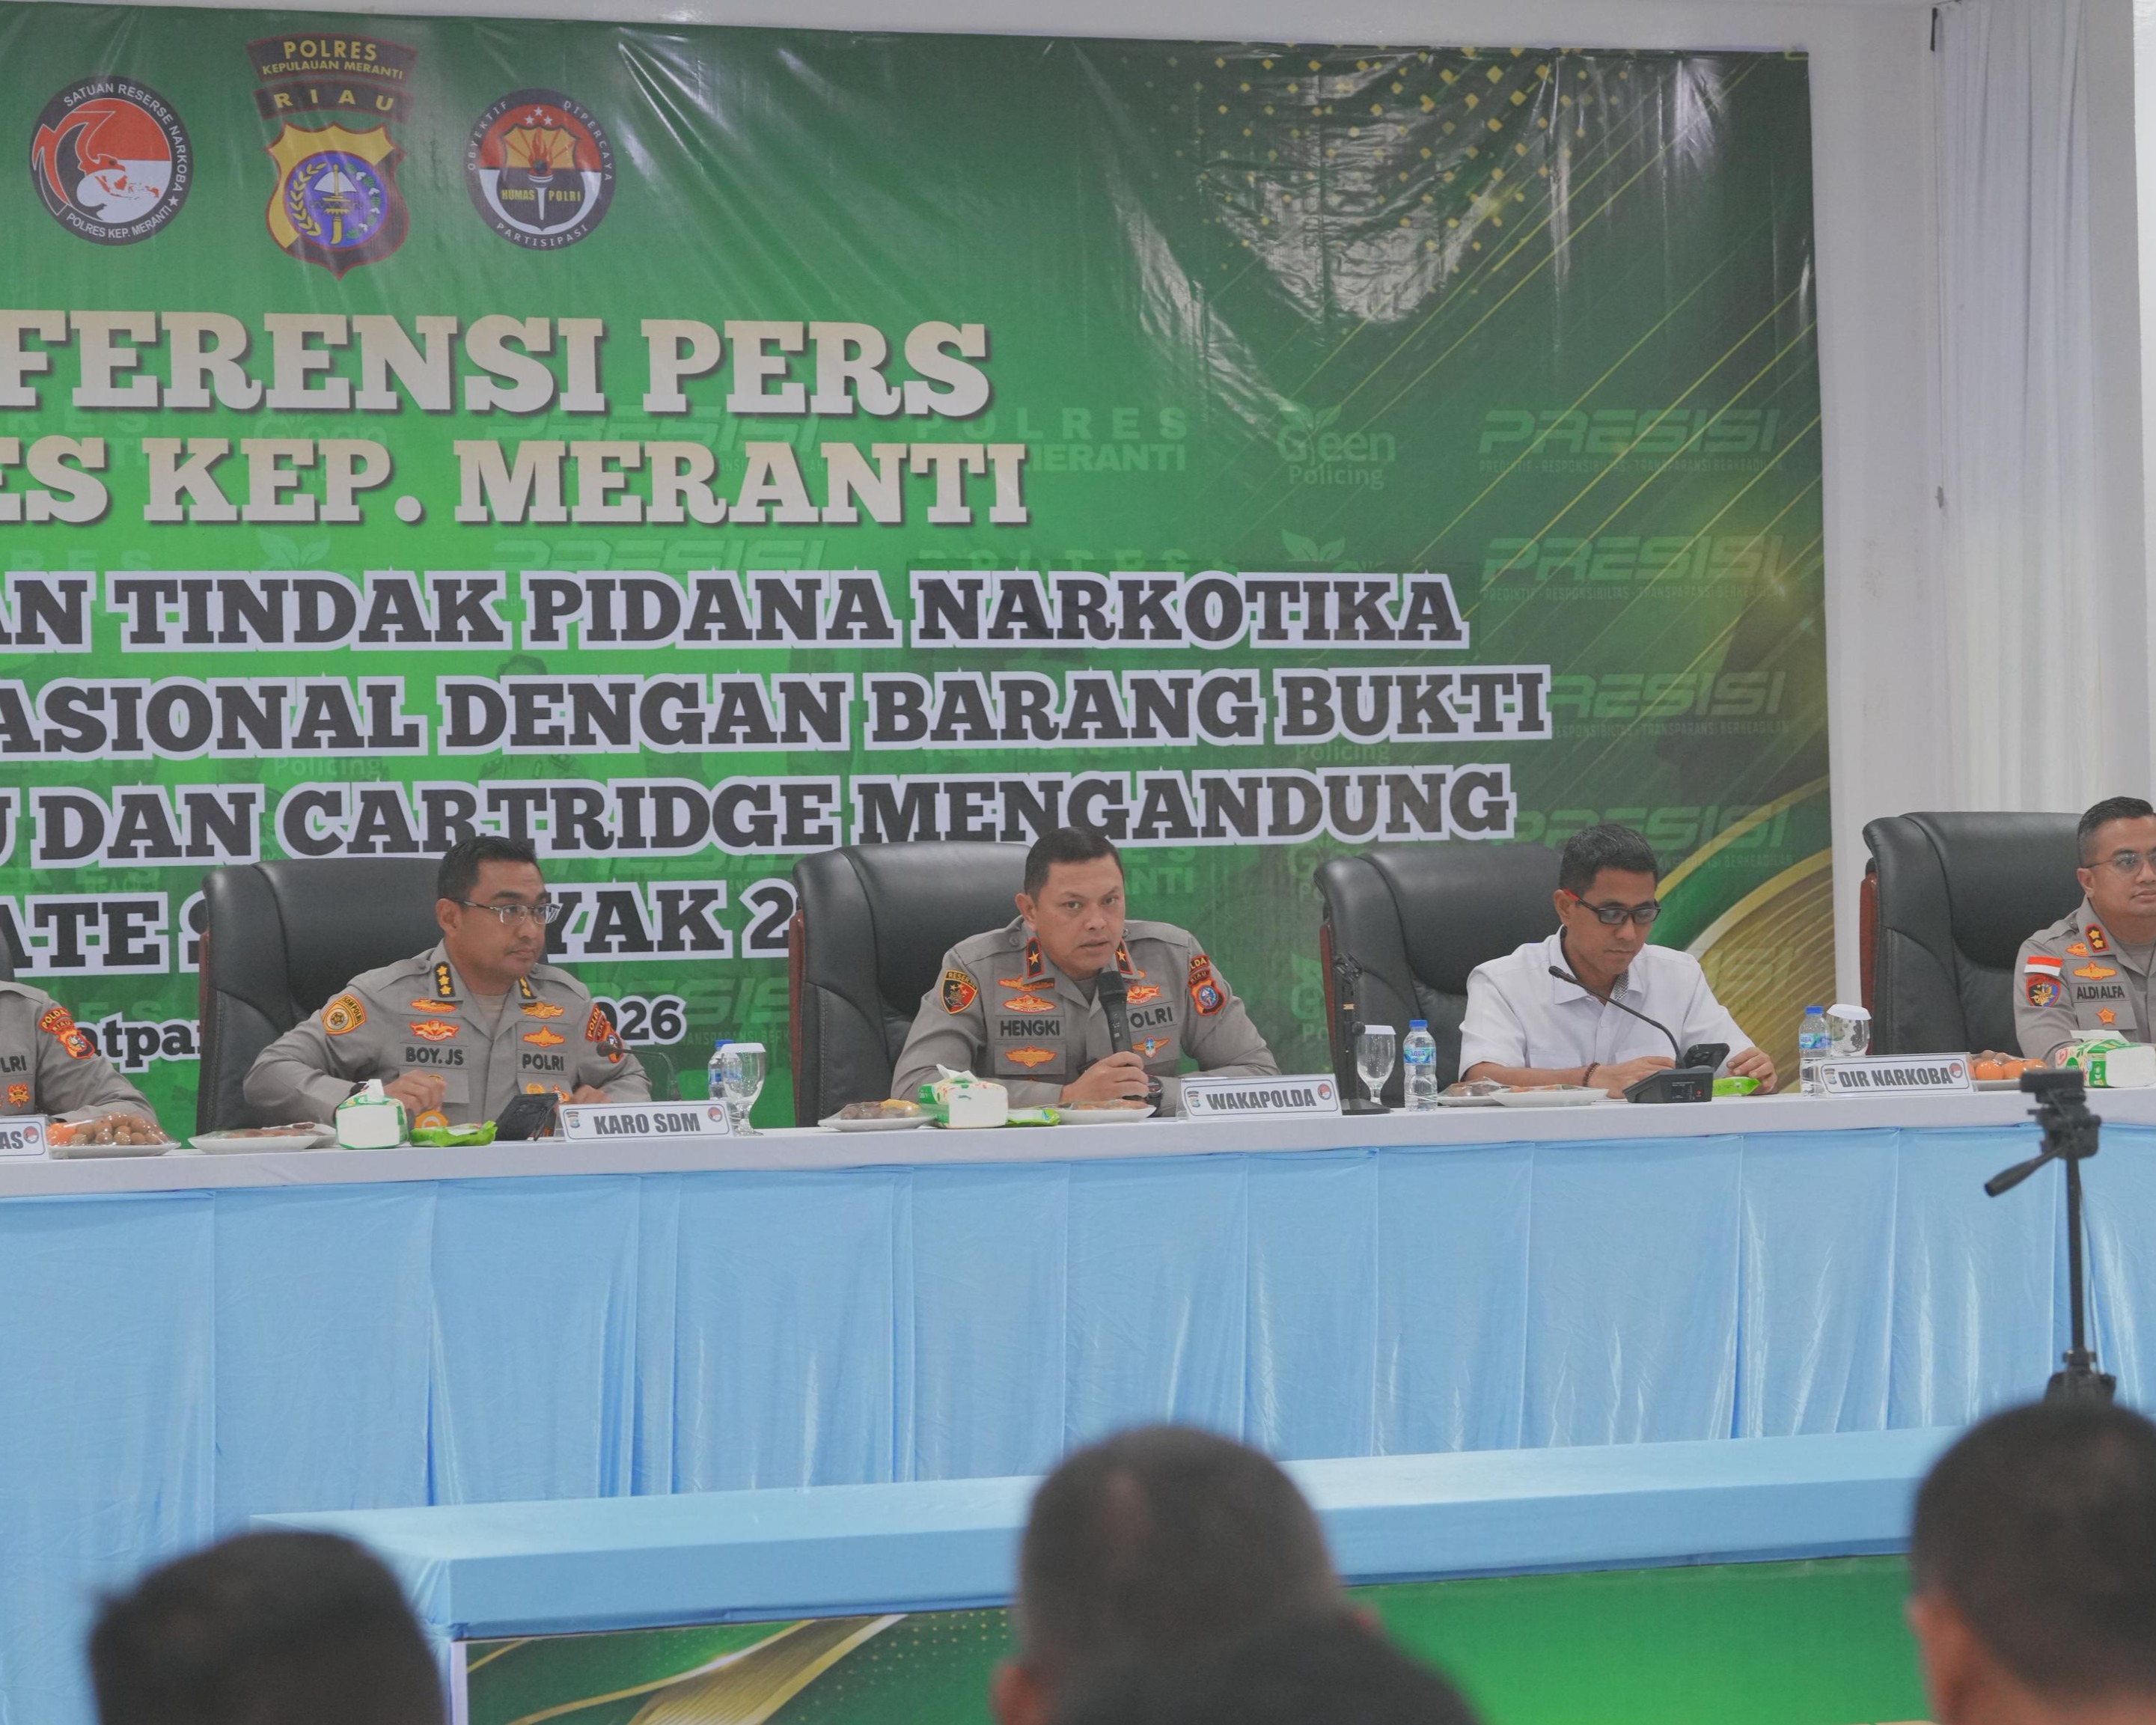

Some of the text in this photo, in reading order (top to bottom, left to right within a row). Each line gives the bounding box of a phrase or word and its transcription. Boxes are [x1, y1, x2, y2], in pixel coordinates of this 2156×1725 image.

[284, 40, 377, 61] POLRES
[262, 60, 403, 79] KEPULAUAN MERANTI
[273, 89, 394, 111] RIAU
[64, 83, 188, 192] SATUAN RESERSE NARKOBA
[468, 101, 507, 171] OBYEKTIF
[564, 100, 613, 181] DIPERCAYA
[501, 189, 581, 201] HUMAS POLRI
[66, 204, 173, 238] POLRES KEP. MERANTI
[497, 222, 588, 247] PARTISIPASI
[641, 319, 989, 416] PERS
[1478, 409, 1781, 454] PRESISI
[142, 438, 423, 522] KEP.
[454, 440, 1027, 524] MERANTI
[1288, 462, 1384, 490] Policing
[1481, 534, 1785, 581] PRESISI
[114, 578, 504, 644] TINDAK
[528, 578, 895, 642] PIDANA
[917, 578, 1463, 642] NARKOTIKA
[445, 680, 846, 748] DENGAN
[870, 676, 1259, 744] BARANG
[1280, 672, 1545, 737] BUKTI
[1295, 741, 1391, 765] Policing
[39, 792, 256, 861] DAN
[282, 782, 834, 858] CARTRIDGE
[858, 771, 1509, 844] MENGANDUNG
[2077, 985, 2125, 1000] ALDI ALFA
[1000, 1019, 1060, 1036] HENGKI
[1129, 1006, 1173, 1028] OLRI
[522, 1054, 564, 1071] POLRI
[1838, 1067, 1954, 1087] DIR NARKOBA
[1206, 1088, 1318, 1111] WAKAPOLDA
[593, 1113, 701, 1135] KARO SDM
